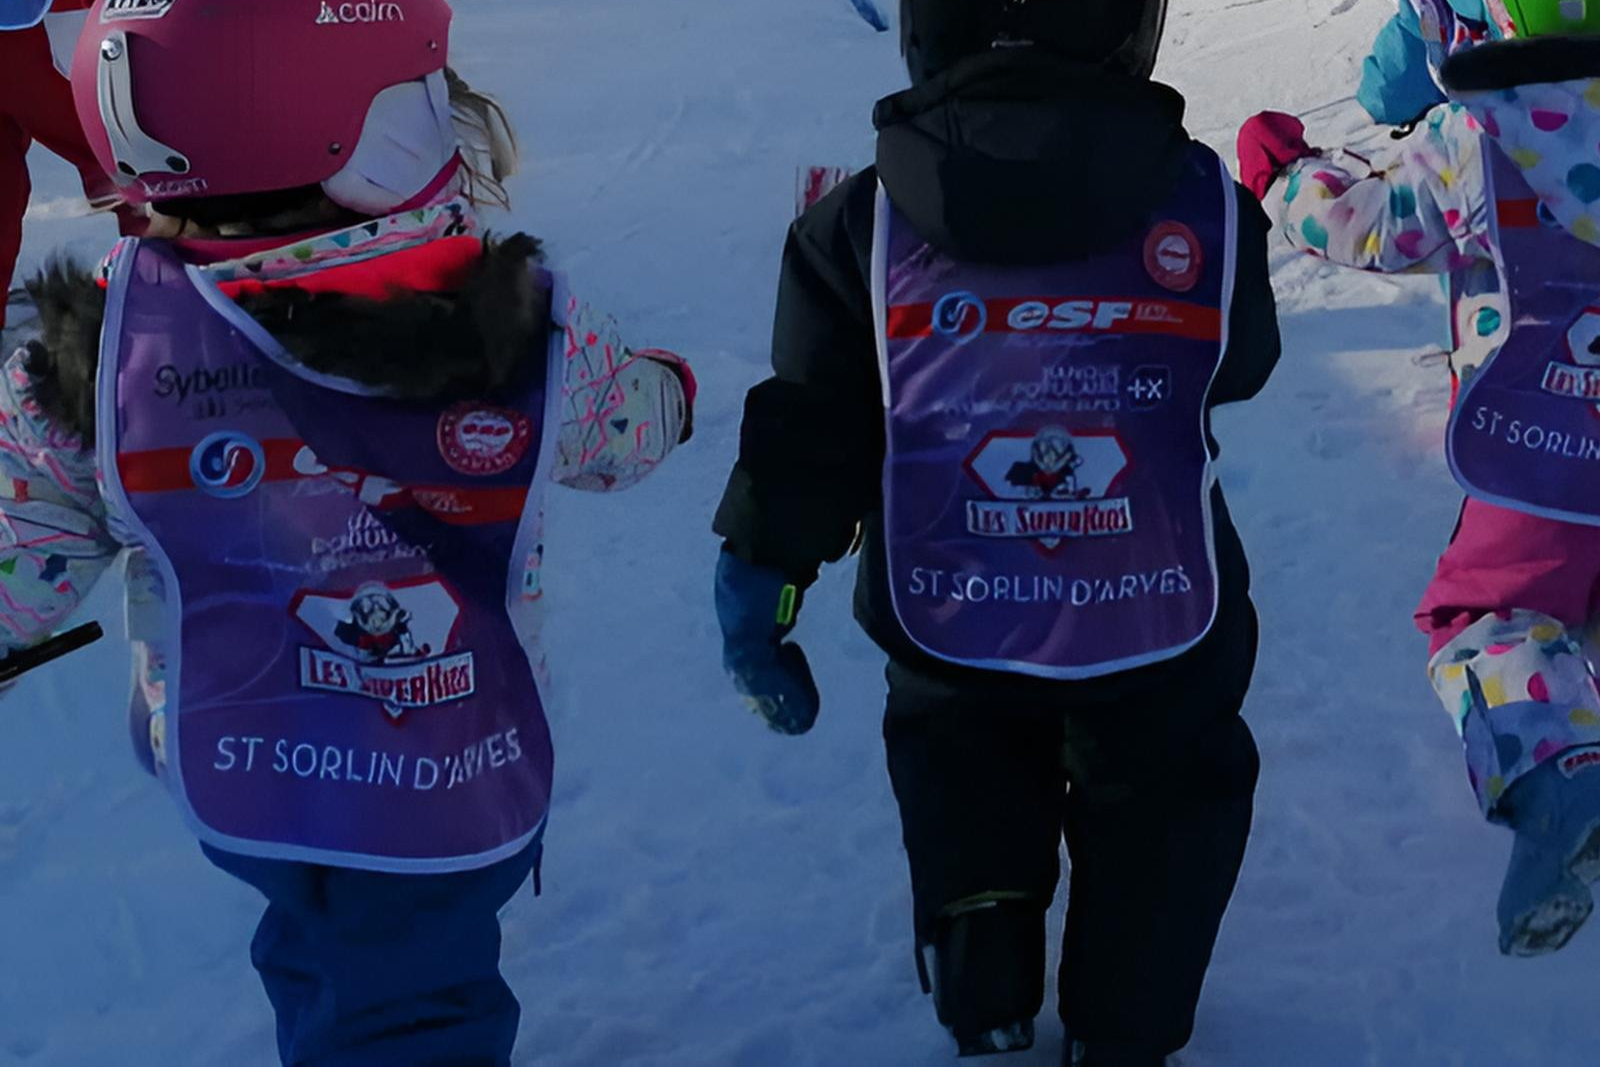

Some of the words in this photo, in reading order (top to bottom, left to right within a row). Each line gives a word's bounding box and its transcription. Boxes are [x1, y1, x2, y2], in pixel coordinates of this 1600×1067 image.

[908, 568, 943, 597] ST
[951, 573, 1063, 604] SORLIN
[213, 736, 264, 772] ST
[272, 738, 405, 786] SORLIN
